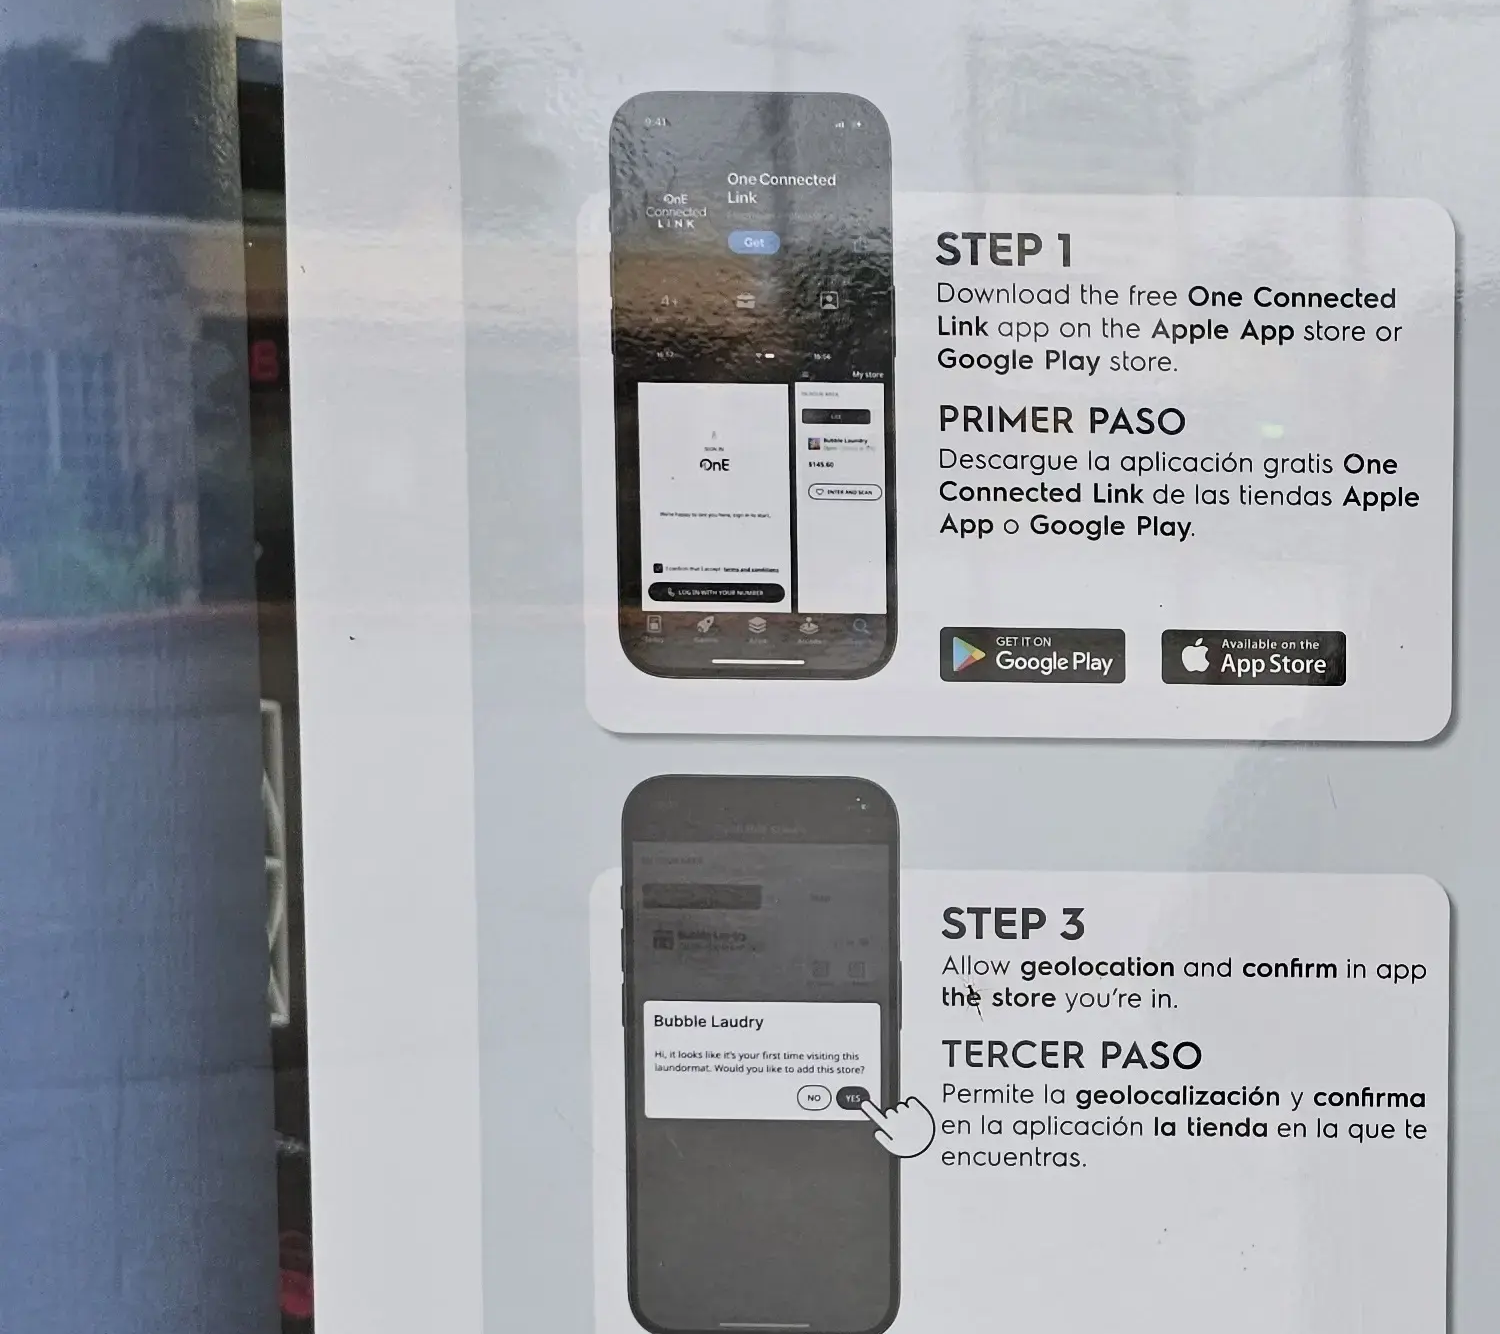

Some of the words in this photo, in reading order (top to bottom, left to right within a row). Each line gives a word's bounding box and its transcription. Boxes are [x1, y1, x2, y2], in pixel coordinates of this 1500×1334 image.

[728, 173, 757, 186] One
[760, 173, 836, 186] Connected
[728, 191, 757, 204] Link
[646, 207, 706, 217] Connected
[744, 237, 764, 248] Get
[936, 232, 1042, 266] STEP
[1058, 233, 1071, 267] 1
[938, 282, 1069, 304] Download
[1080, 284, 1119, 305] the
[1130, 285, 1177, 306] free
[1188, 285, 1243, 307] One
[1254, 286, 1396, 308] Connected
[937, 348, 1033, 375] Google
[1046, 350, 1100, 376] Play
[1110, 351, 1177, 372] store.
[852, 371, 863, 379] My
[940, 405, 1073, 433] PRIMER
[1090, 407, 1185, 435] PASO
[997, 637, 1018, 647] GET
[1022, 637, 1030, 647] IT
[1033, 637, 1051, 647] ON
[1222, 638, 1277, 650] Available
[1281, 642, 1295, 650] on
[1300, 639, 1319, 650] the
[996, 651, 1068, 675] Google
[1073, 652, 1113, 675] Play
[1220, 654, 1265, 677] App
[1270, 655, 1326, 673] Store
[942, 907, 1046, 939] STEP
[1060, 908, 1084, 940] 3
[654, 1015, 707, 1027] Bubble
[712, 1015, 764, 1030] Laudry
[942, 1040, 1084, 1068] TERCER
[1102, 1041, 1202, 1070] PASO
[715, 1065, 744, 1073] Would
[746, 1066, 764, 1074] you
[766, 1065, 782, 1073] like
[797, 1065, 814, 1074] add
[817, 1065, 834, 1074] this
[837, 1065, 865, 1074] store?
[846, 1094, 860, 1102] YES
[943, 1083, 1034, 1104] Permite
[1045, 1084, 1065, 1104] la
[1076, 1085, 1279, 1110] geolocalización
[1291, 1091, 1303, 1111] y
[1314, 1087, 1425, 1108] confirma
